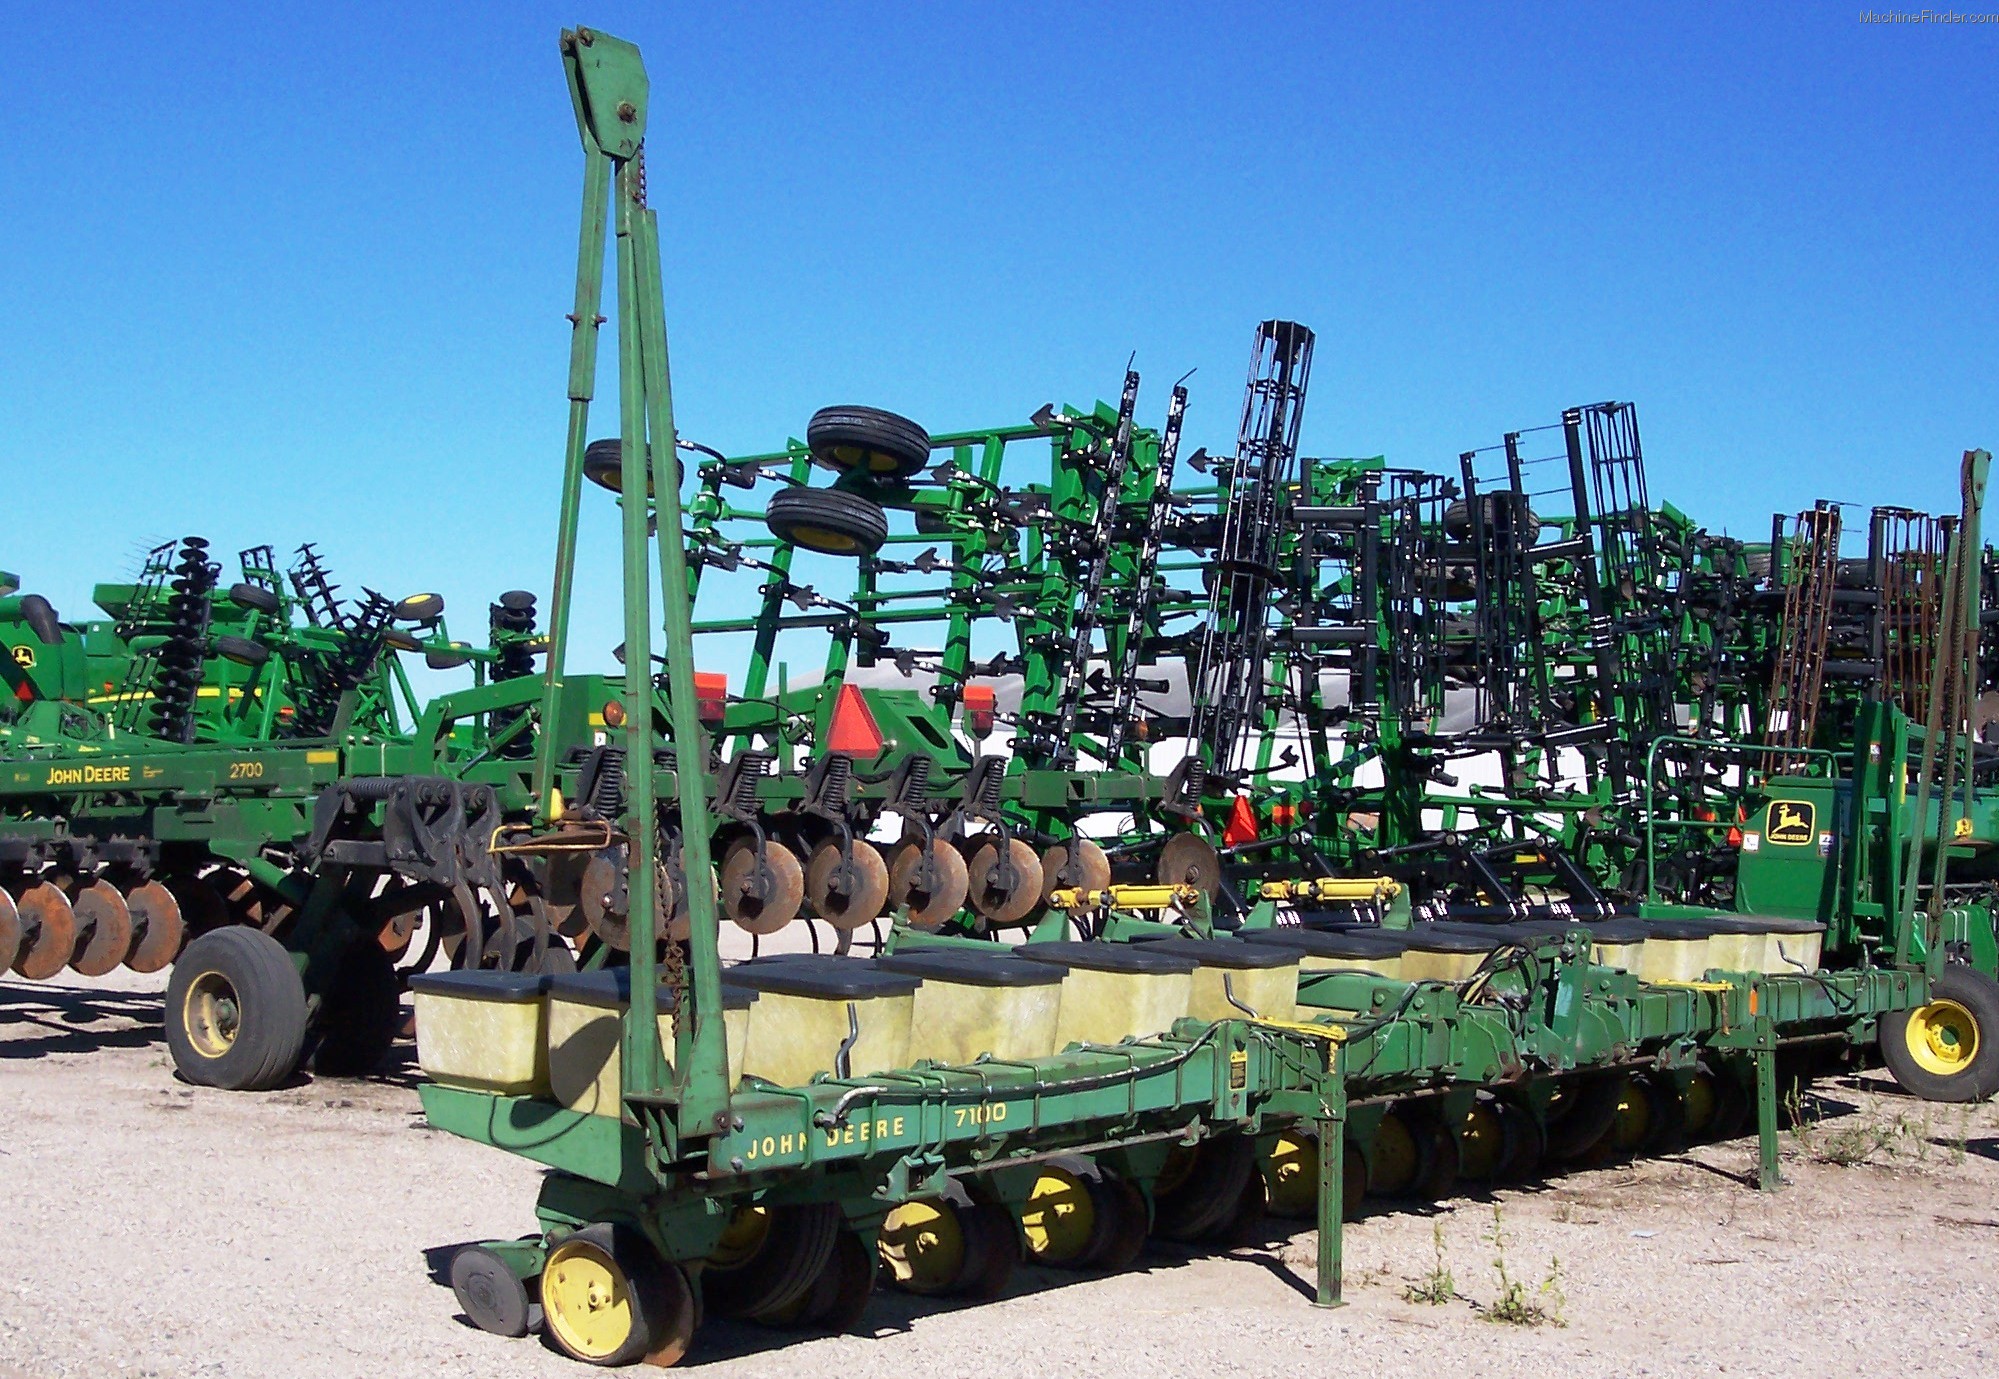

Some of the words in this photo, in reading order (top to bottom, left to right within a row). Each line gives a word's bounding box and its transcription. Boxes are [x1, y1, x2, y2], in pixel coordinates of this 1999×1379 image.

[46, 767, 82, 785] JOHN
[84, 764, 130, 782] DEERE
[229, 762, 263, 779] 2700
[954, 1102, 1007, 1128] 7100
